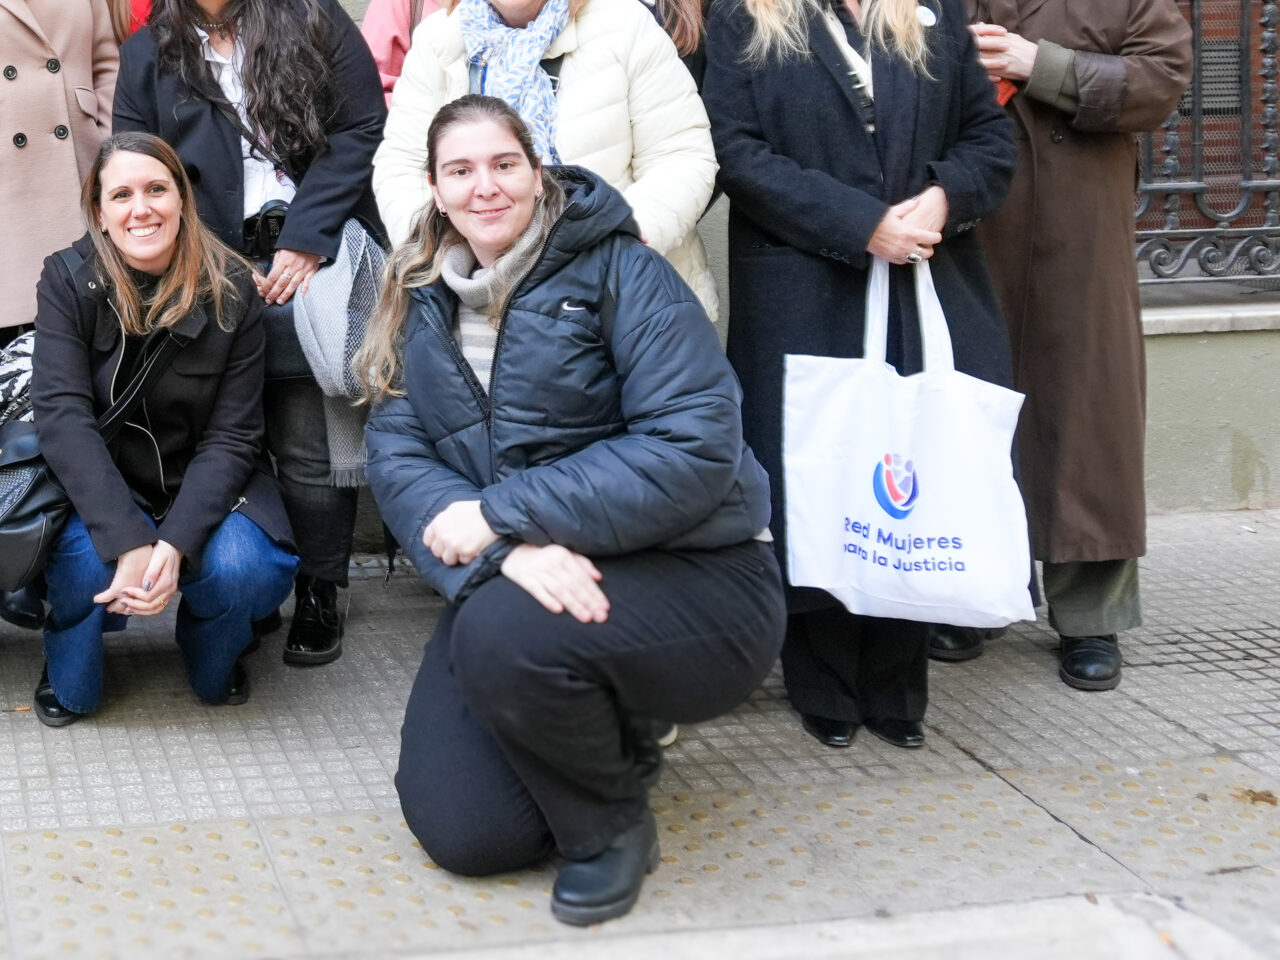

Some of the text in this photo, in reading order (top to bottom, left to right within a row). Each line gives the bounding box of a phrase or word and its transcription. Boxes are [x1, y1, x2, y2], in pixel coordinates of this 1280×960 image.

[876, 528, 964, 554] Mujeres
[872, 550, 889, 567] la
[892, 557, 966, 572] Justicia
